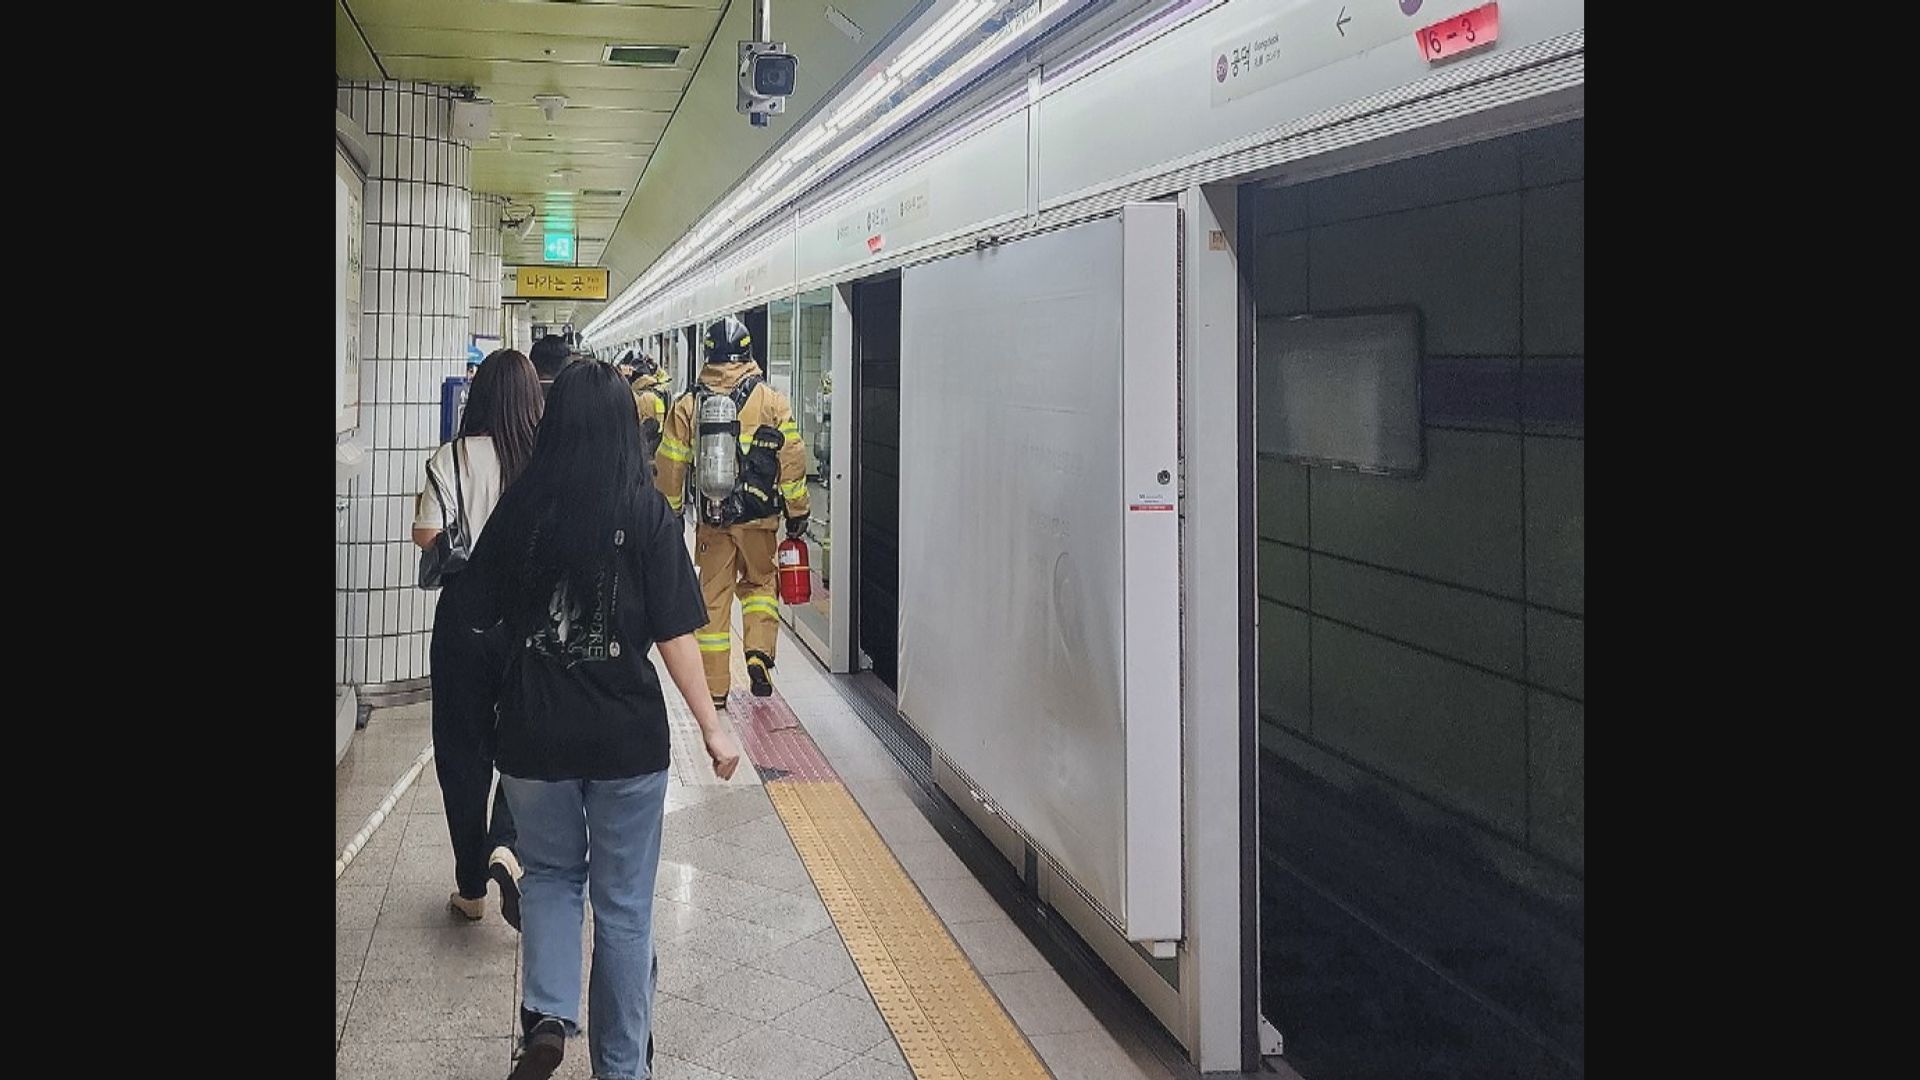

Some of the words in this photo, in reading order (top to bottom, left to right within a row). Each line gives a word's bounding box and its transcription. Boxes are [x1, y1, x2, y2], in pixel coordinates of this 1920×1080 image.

[1231, 42, 1251, 77] 공덕
[527, 274, 566, 291] 나가는
[571, 276, 584, 291] 곳
